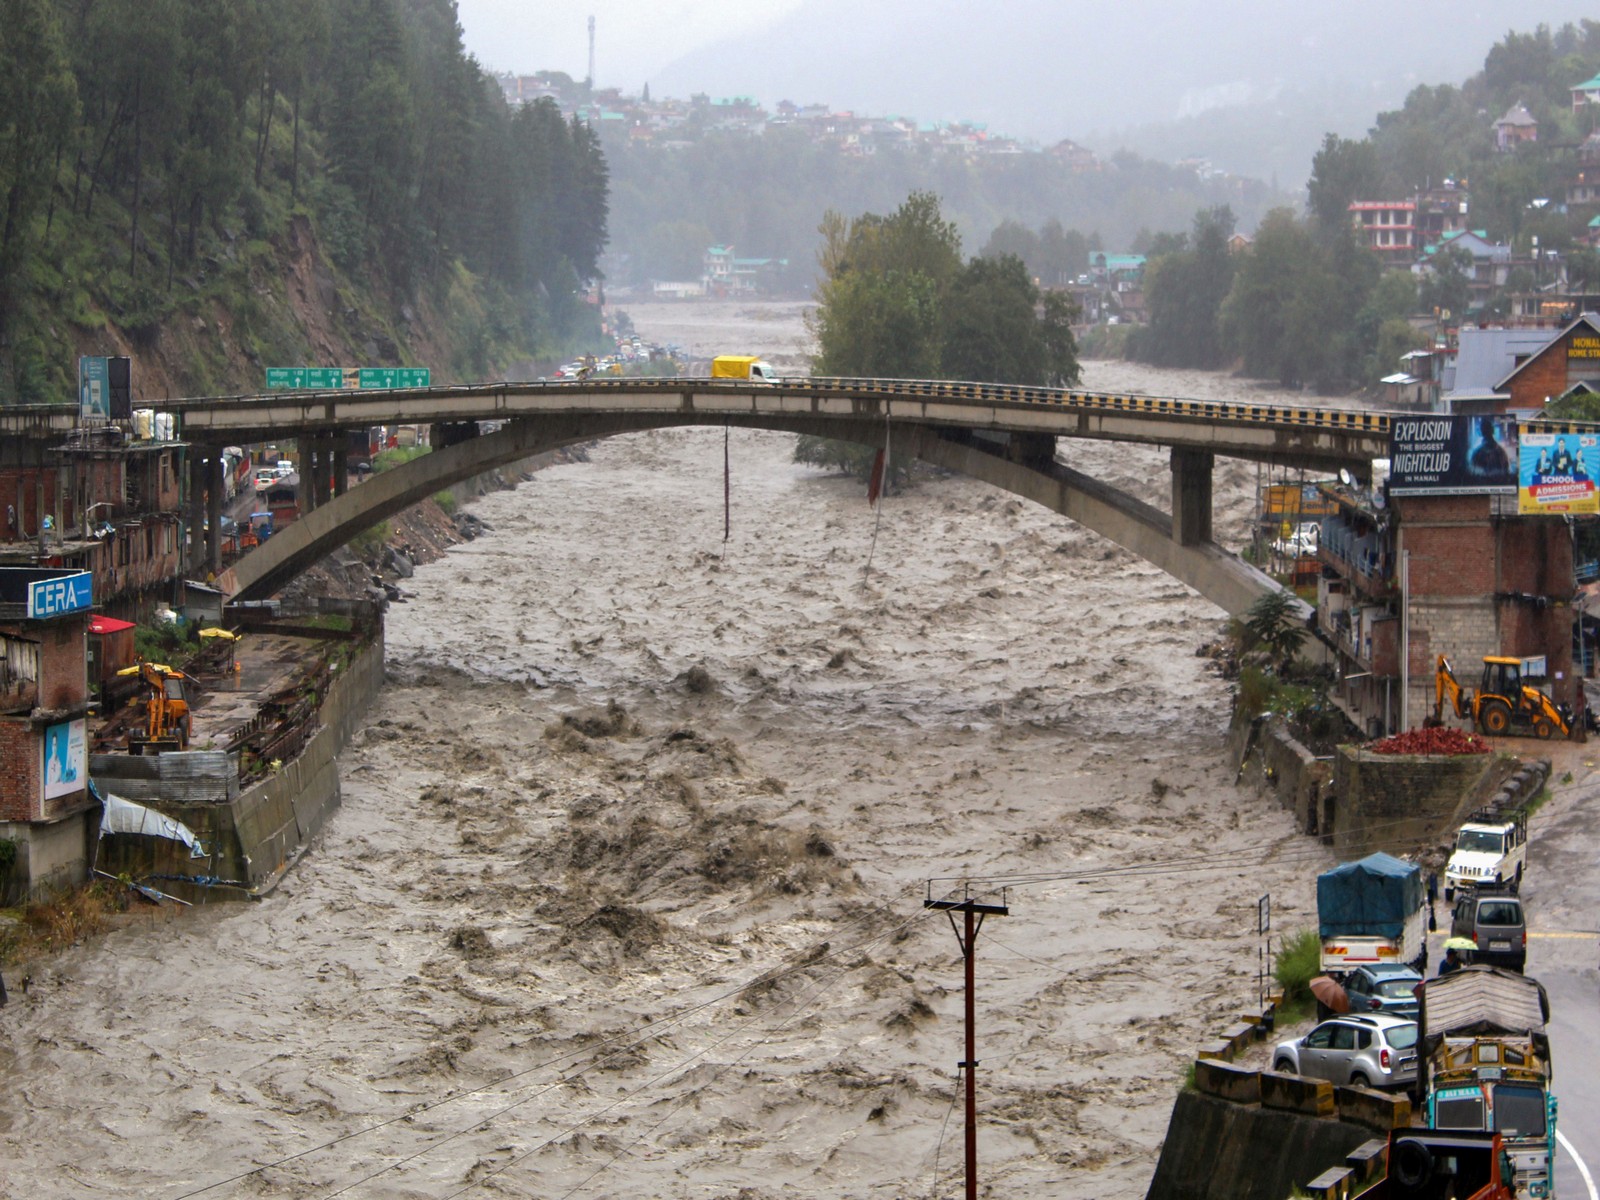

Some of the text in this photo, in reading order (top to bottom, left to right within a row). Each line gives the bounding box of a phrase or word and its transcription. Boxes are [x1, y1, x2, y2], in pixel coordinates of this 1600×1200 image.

[1573, 337, 1600, 348] MONAL
[1568, 349, 1586, 358] HOME
[1394, 421, 1452, 442] EXPLOSION
[1414, 443, 1444, 451] BIGGEST
[1393, 453, 1451, 473] NIGHTCLUB
[1541, 475, 1575, 484] SCHOOL
[1536, 483, 1587, 495] ADMISSIONS
[35, 581, 78, 615] CERA
